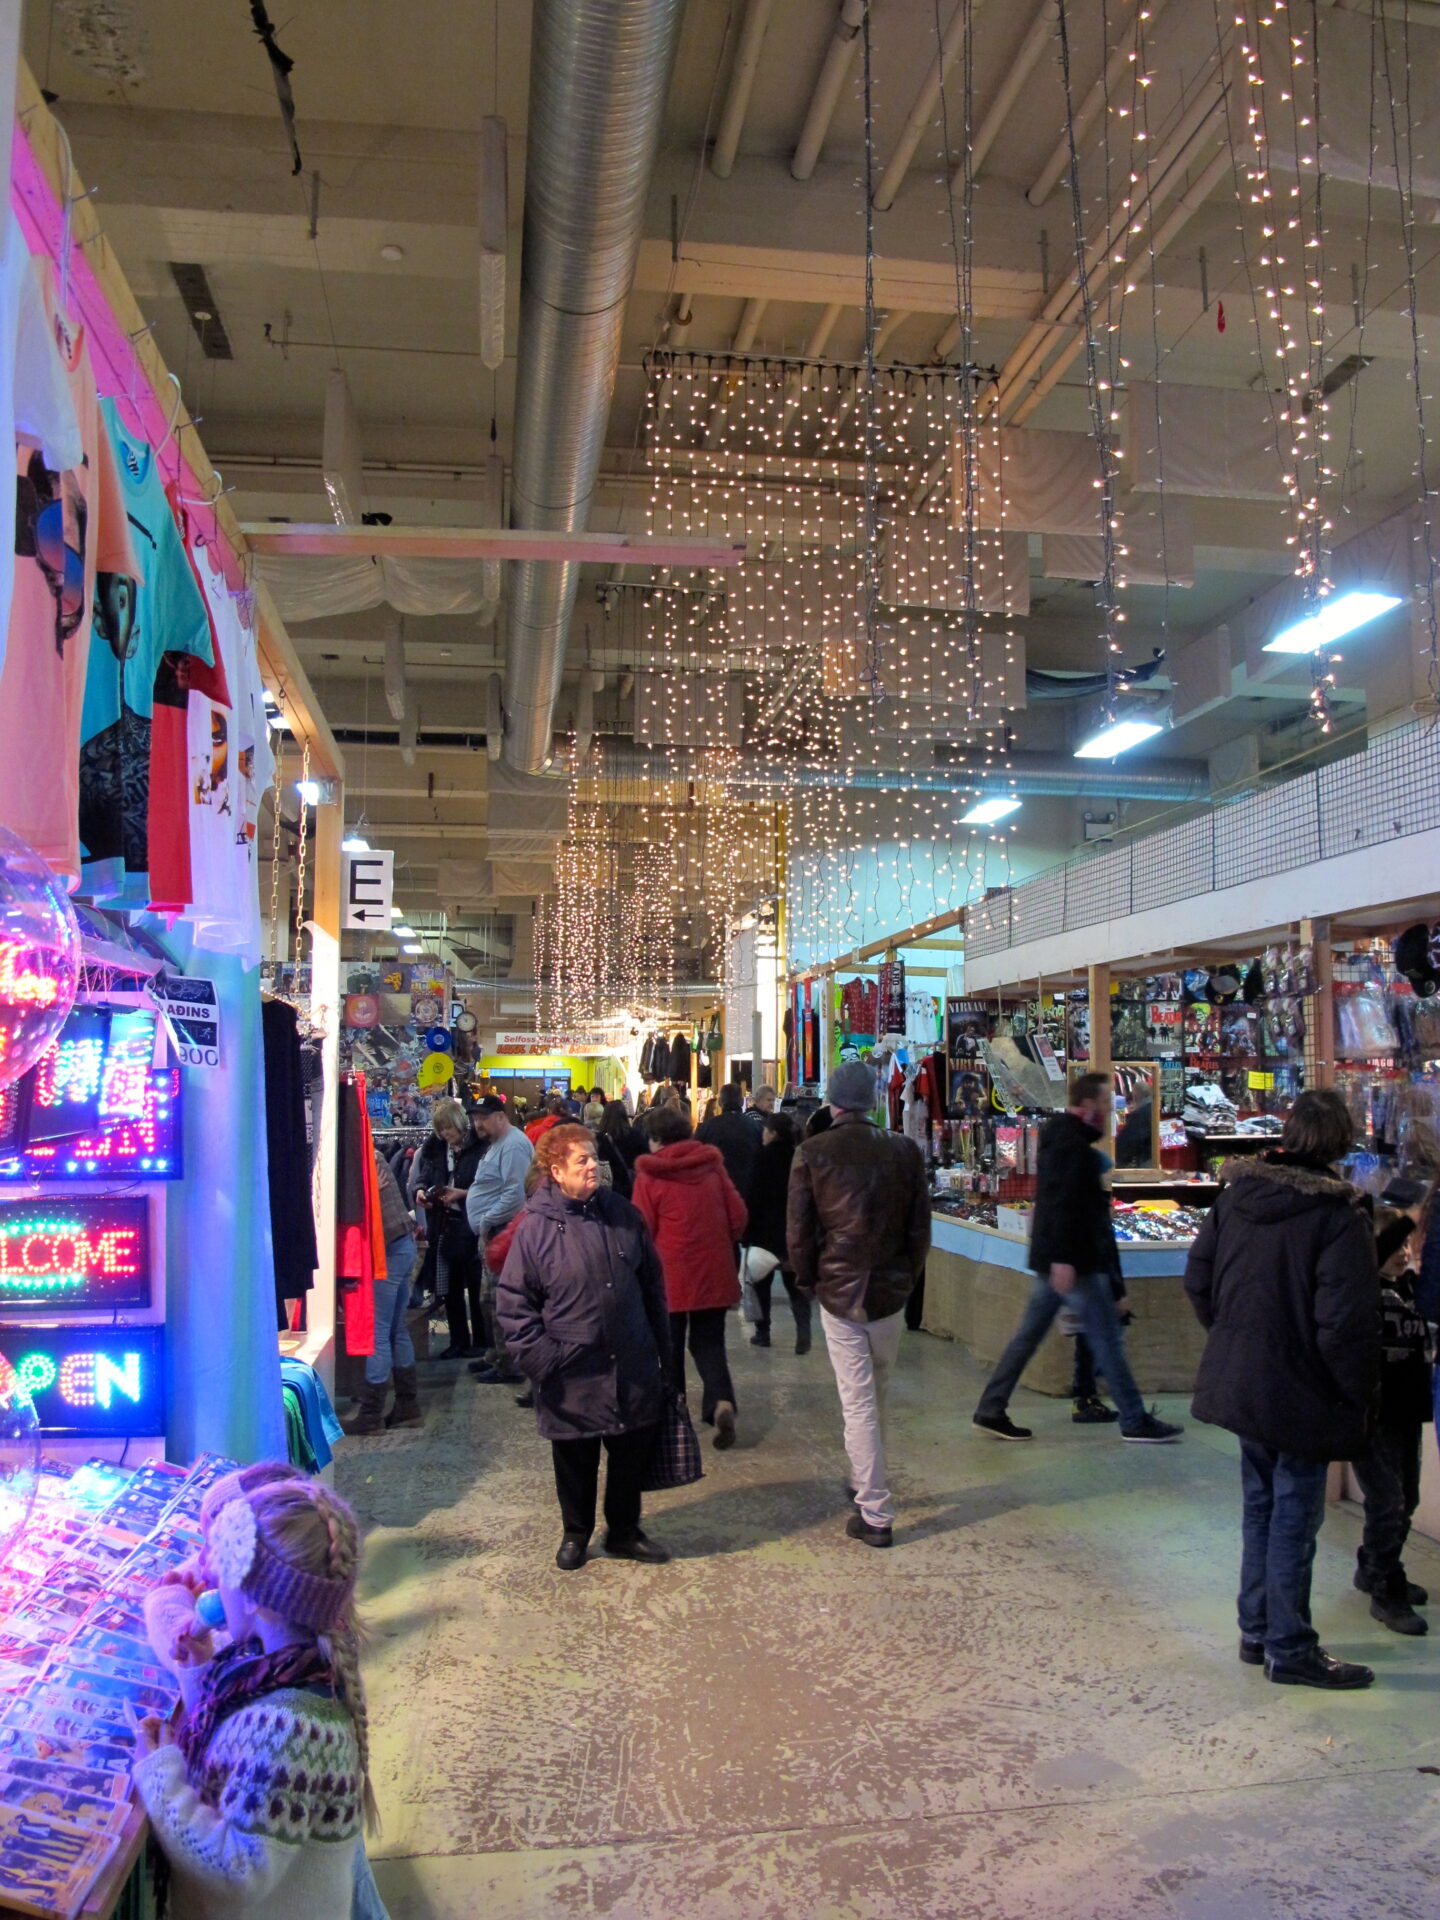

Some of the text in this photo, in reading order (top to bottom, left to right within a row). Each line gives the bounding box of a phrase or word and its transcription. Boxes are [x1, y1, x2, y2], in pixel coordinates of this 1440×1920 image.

[349, 859, 384, 906] E
[167, 1004, 210, 1019] AÐINS
[504, 1035, 535, 1043] Selfoss
